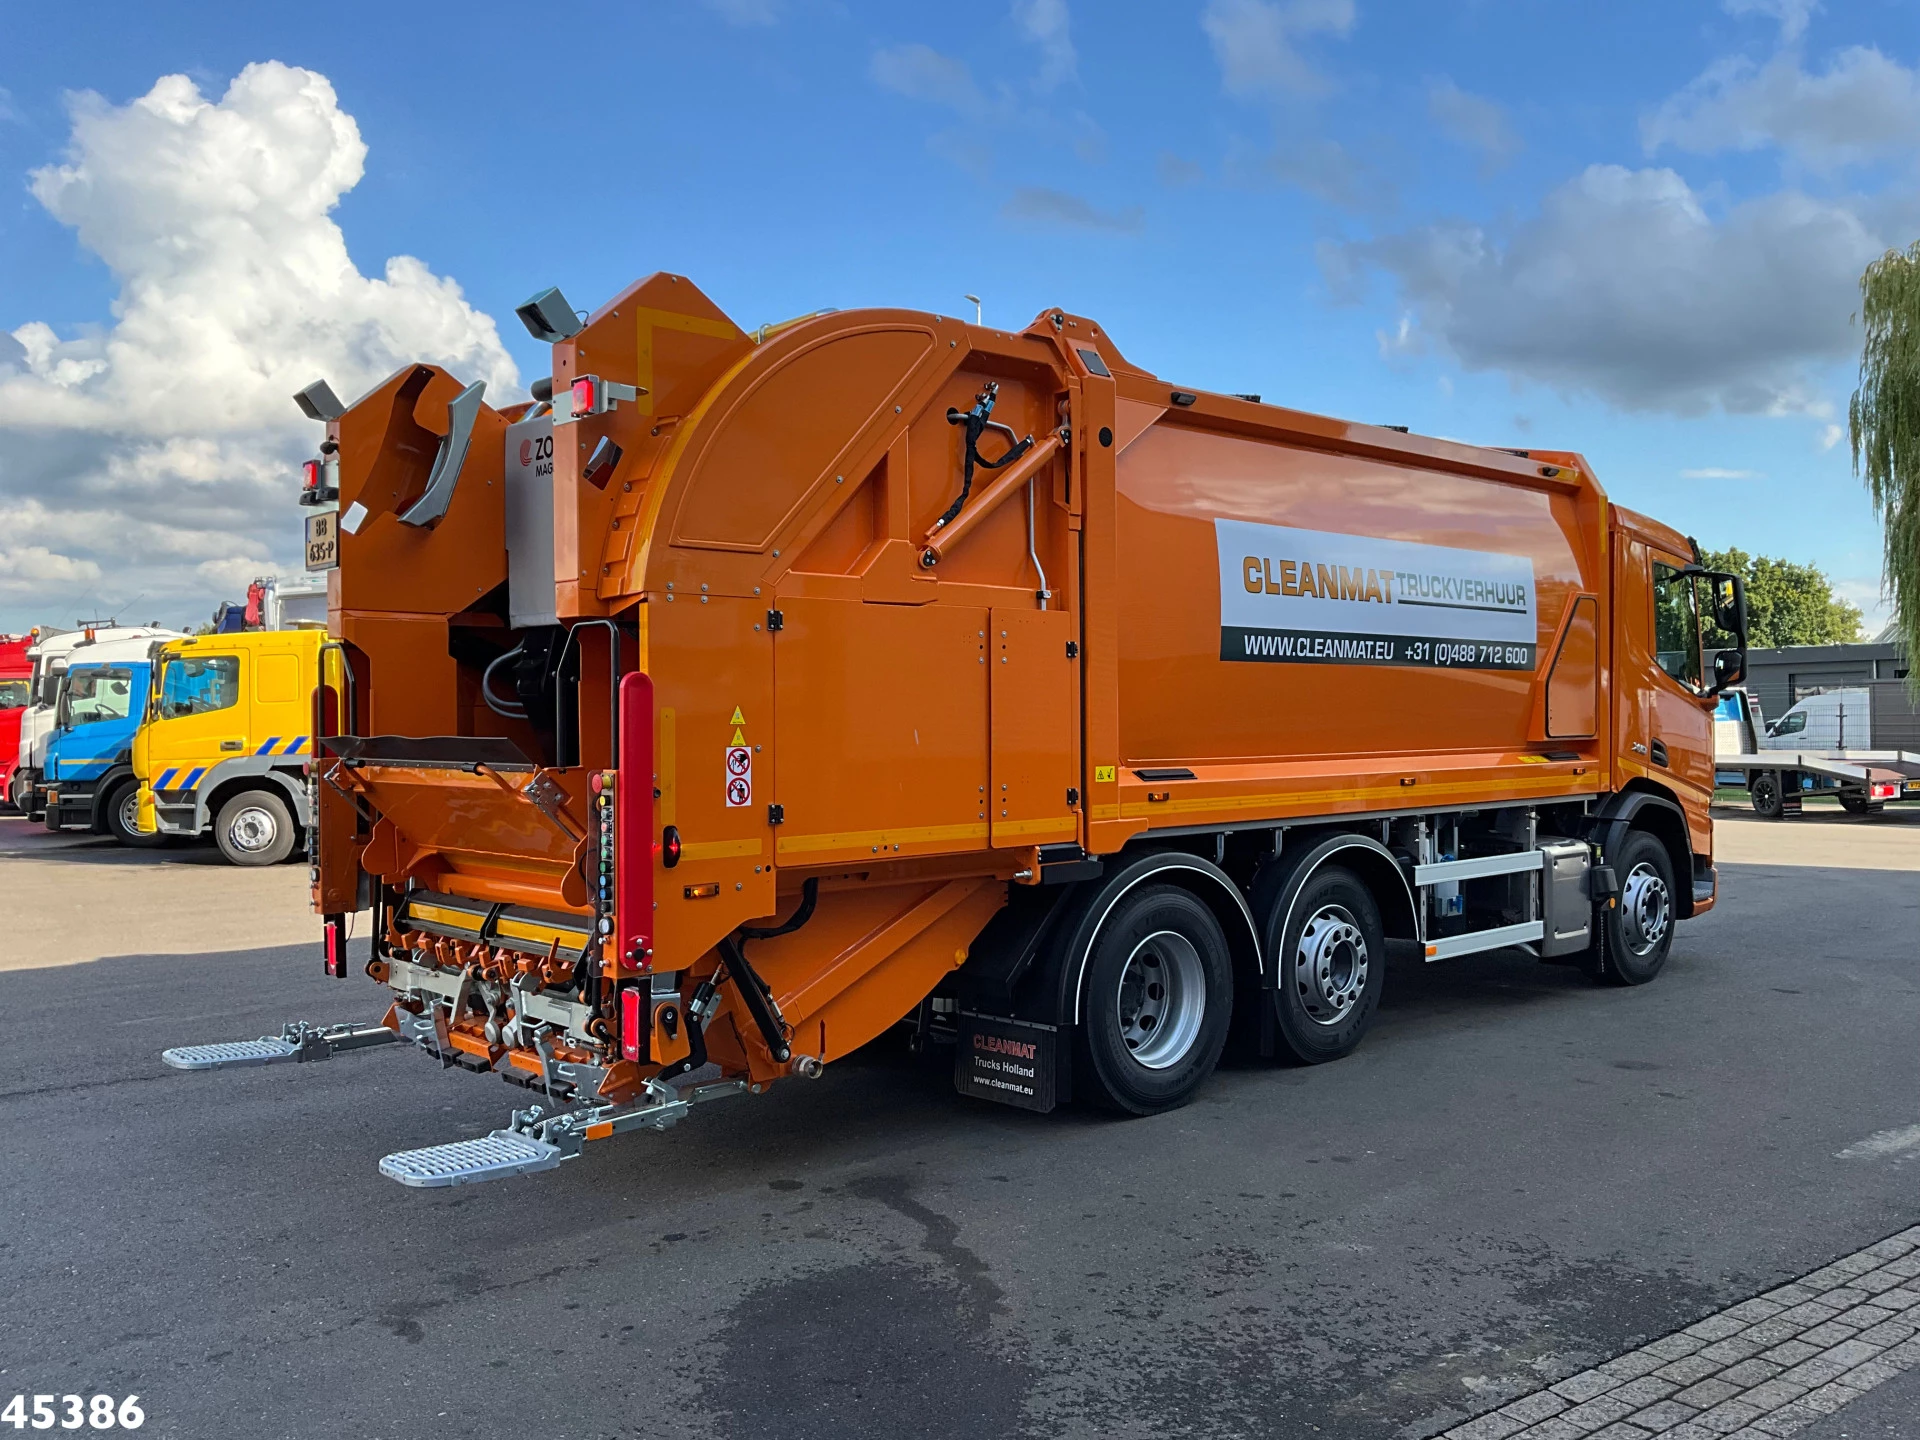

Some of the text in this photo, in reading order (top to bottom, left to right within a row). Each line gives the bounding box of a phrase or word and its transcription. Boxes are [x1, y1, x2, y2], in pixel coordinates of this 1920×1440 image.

[1243, 556, 1526, 605] CLEANMAT TRUCKVERHUUR
[1244, 634, 1528, 666] WWW.CLEANMAT.EU +31 (0)488 712 600
[973, 1034, 1036, 1059] CLEANMAT
[974, 1056, 1034, 1077] Trucks Holland
[973, 1075, 1034, 1095] www.cleanmat.eu
